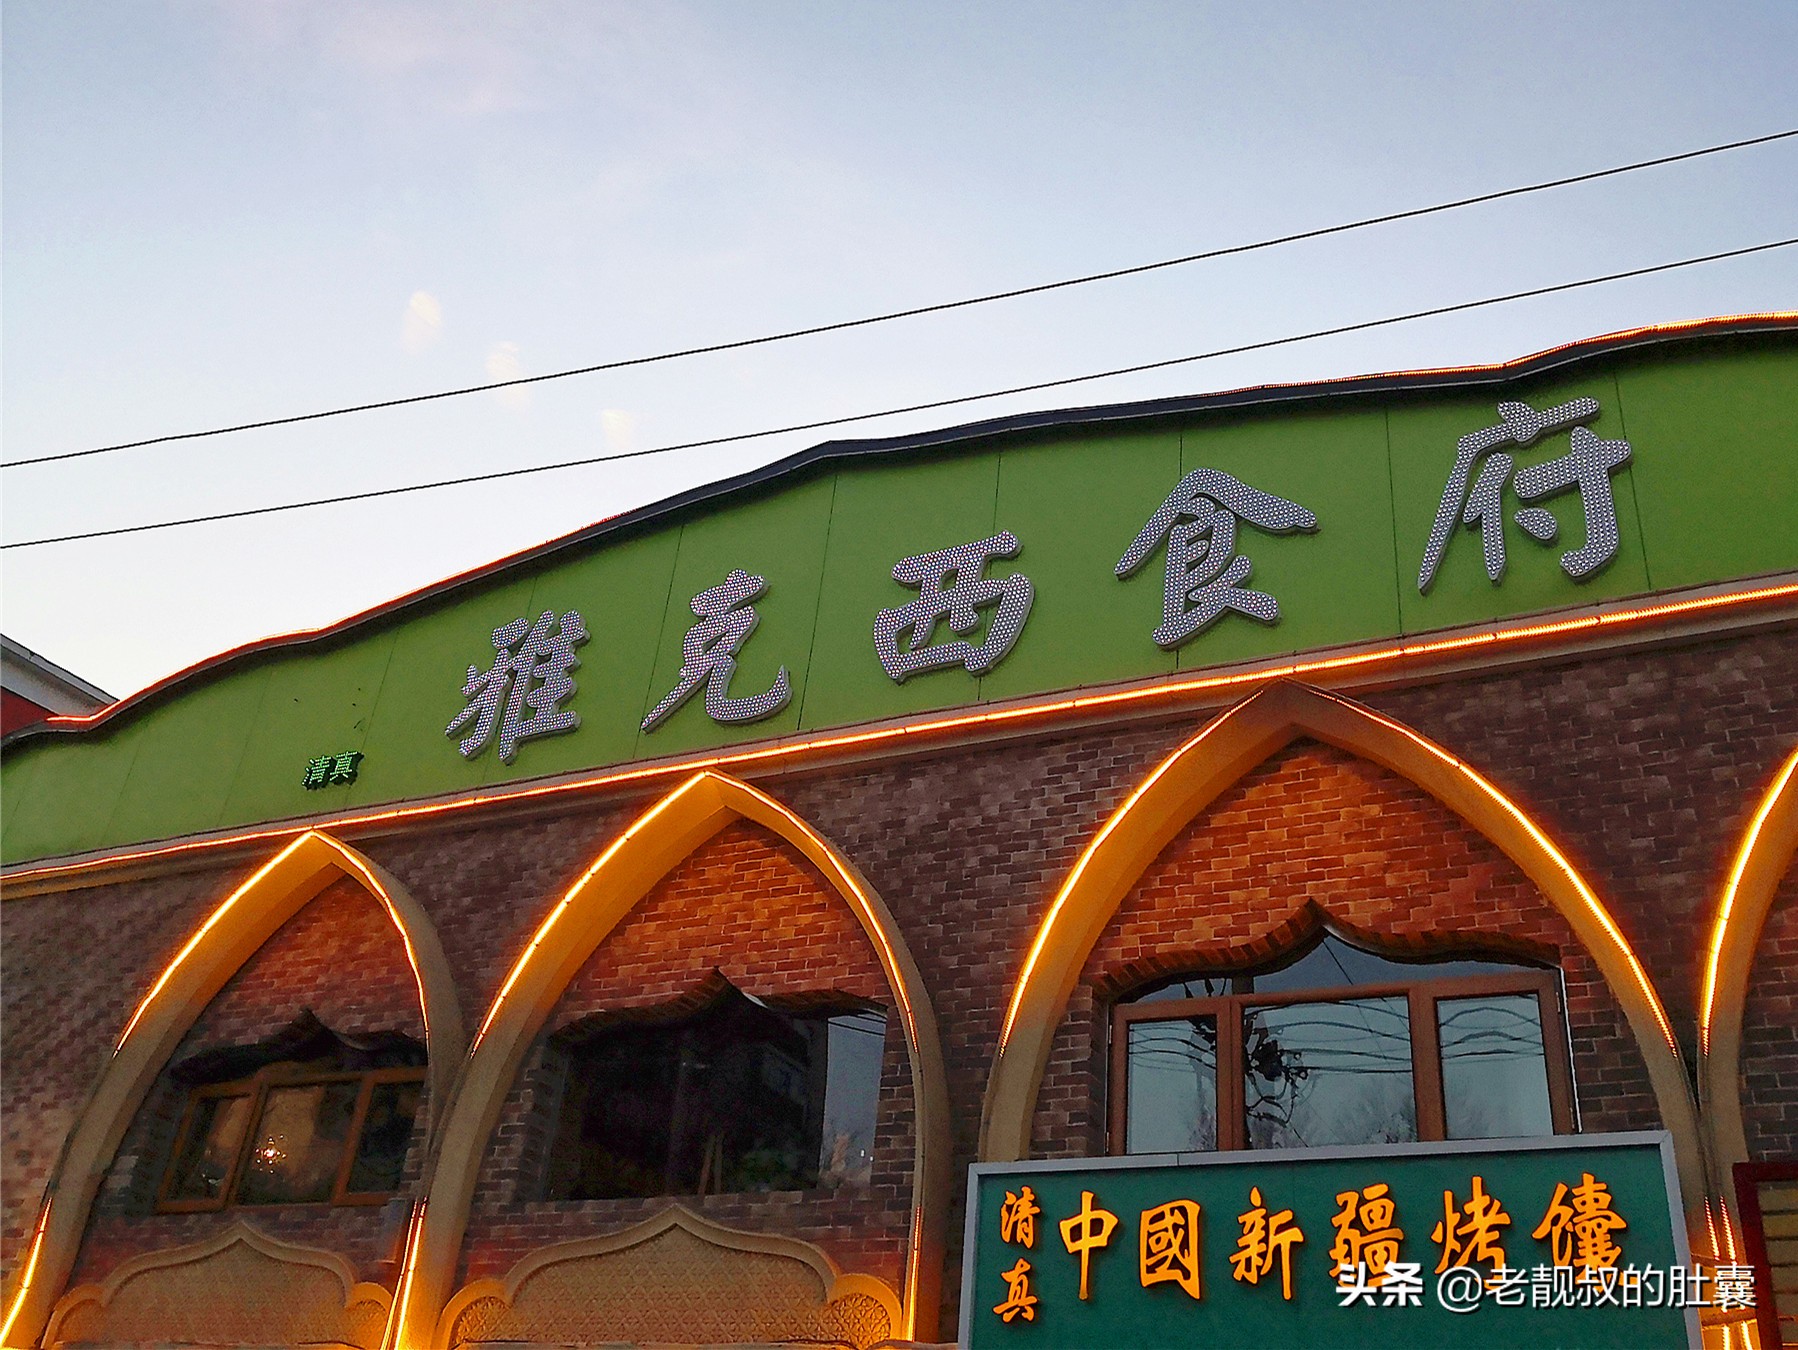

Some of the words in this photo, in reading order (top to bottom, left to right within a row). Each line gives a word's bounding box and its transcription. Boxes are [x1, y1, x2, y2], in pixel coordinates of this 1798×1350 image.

[445, 396, 1632, 764] 雅克西食府
[302, 751, 363, 790] 清真
[993, 1186, 1041, 1323] 清真
